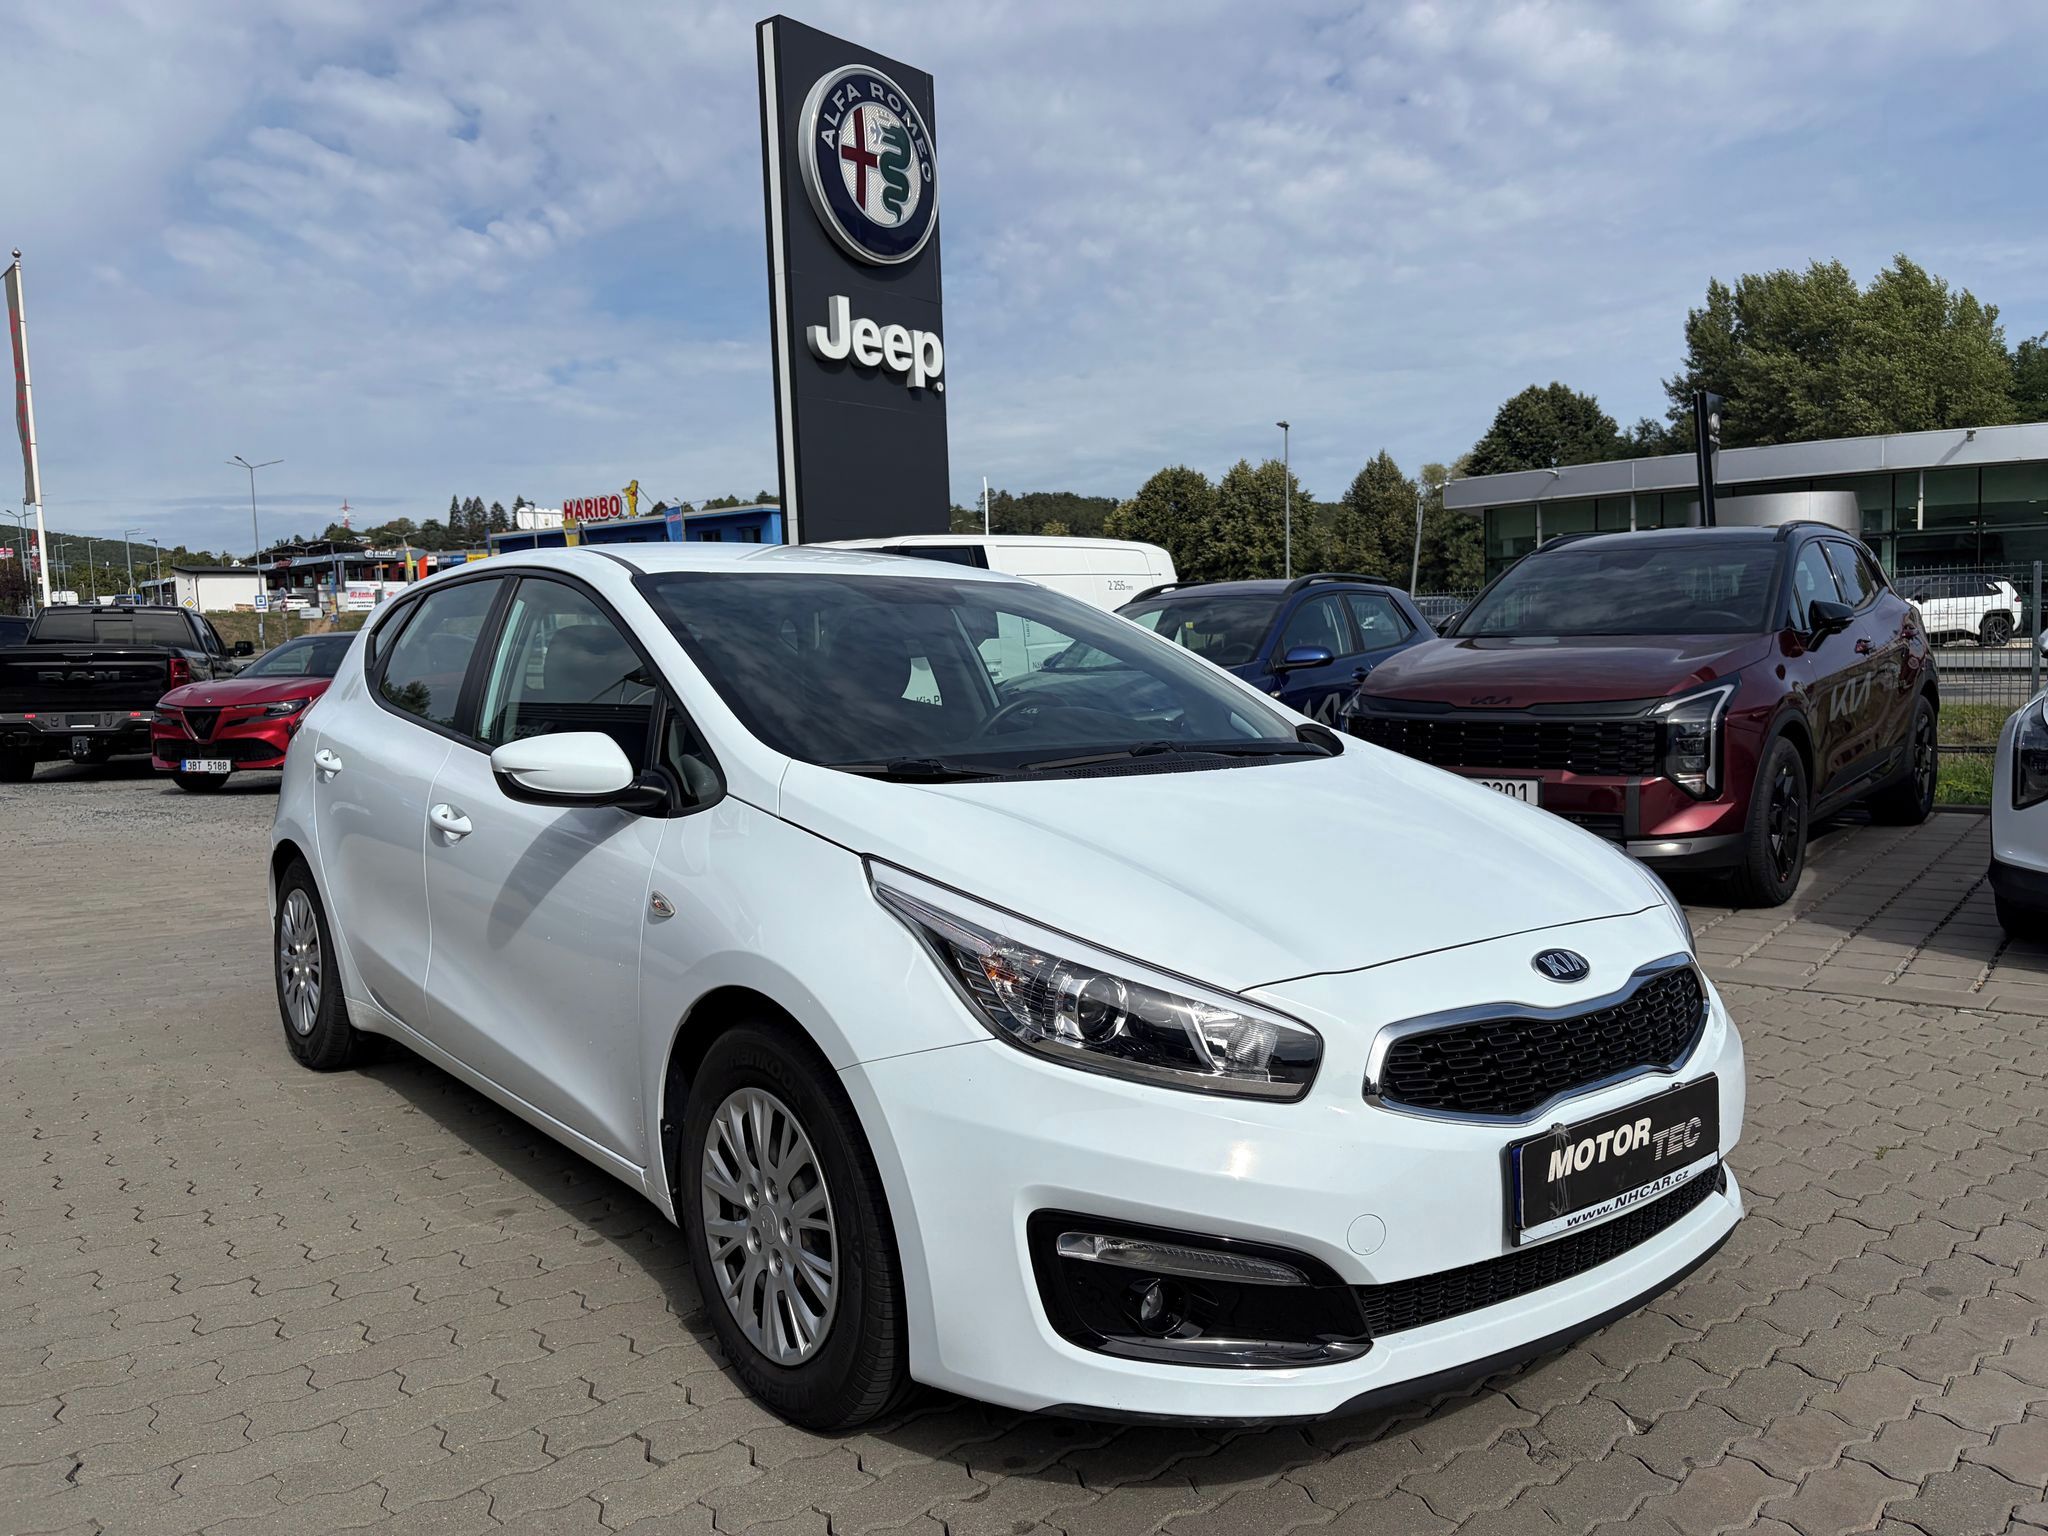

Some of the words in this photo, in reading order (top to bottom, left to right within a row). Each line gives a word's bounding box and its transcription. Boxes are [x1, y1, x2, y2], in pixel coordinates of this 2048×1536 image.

[821, 83, 862, 150] ALFA
[869, 81, 932, 183] ROMEO
[806, 294, 943, 388] Jeep
[563, 494, 622, 520] HARIBO
[37, 670, 121, 681] RAM
[1829, 671, 1872, 722] KIA
[187, 761, 202, 771] 3BT
[207, 761, 228, 771] 5188
[1539, 951, 1588, 977] KIA
[1547, 1117, 1652, 1183] MOTOR
[1652, 1116, 1702, 1161] TEC
[1566, 1169, 1690, 1227] www.NHCAR.cz
